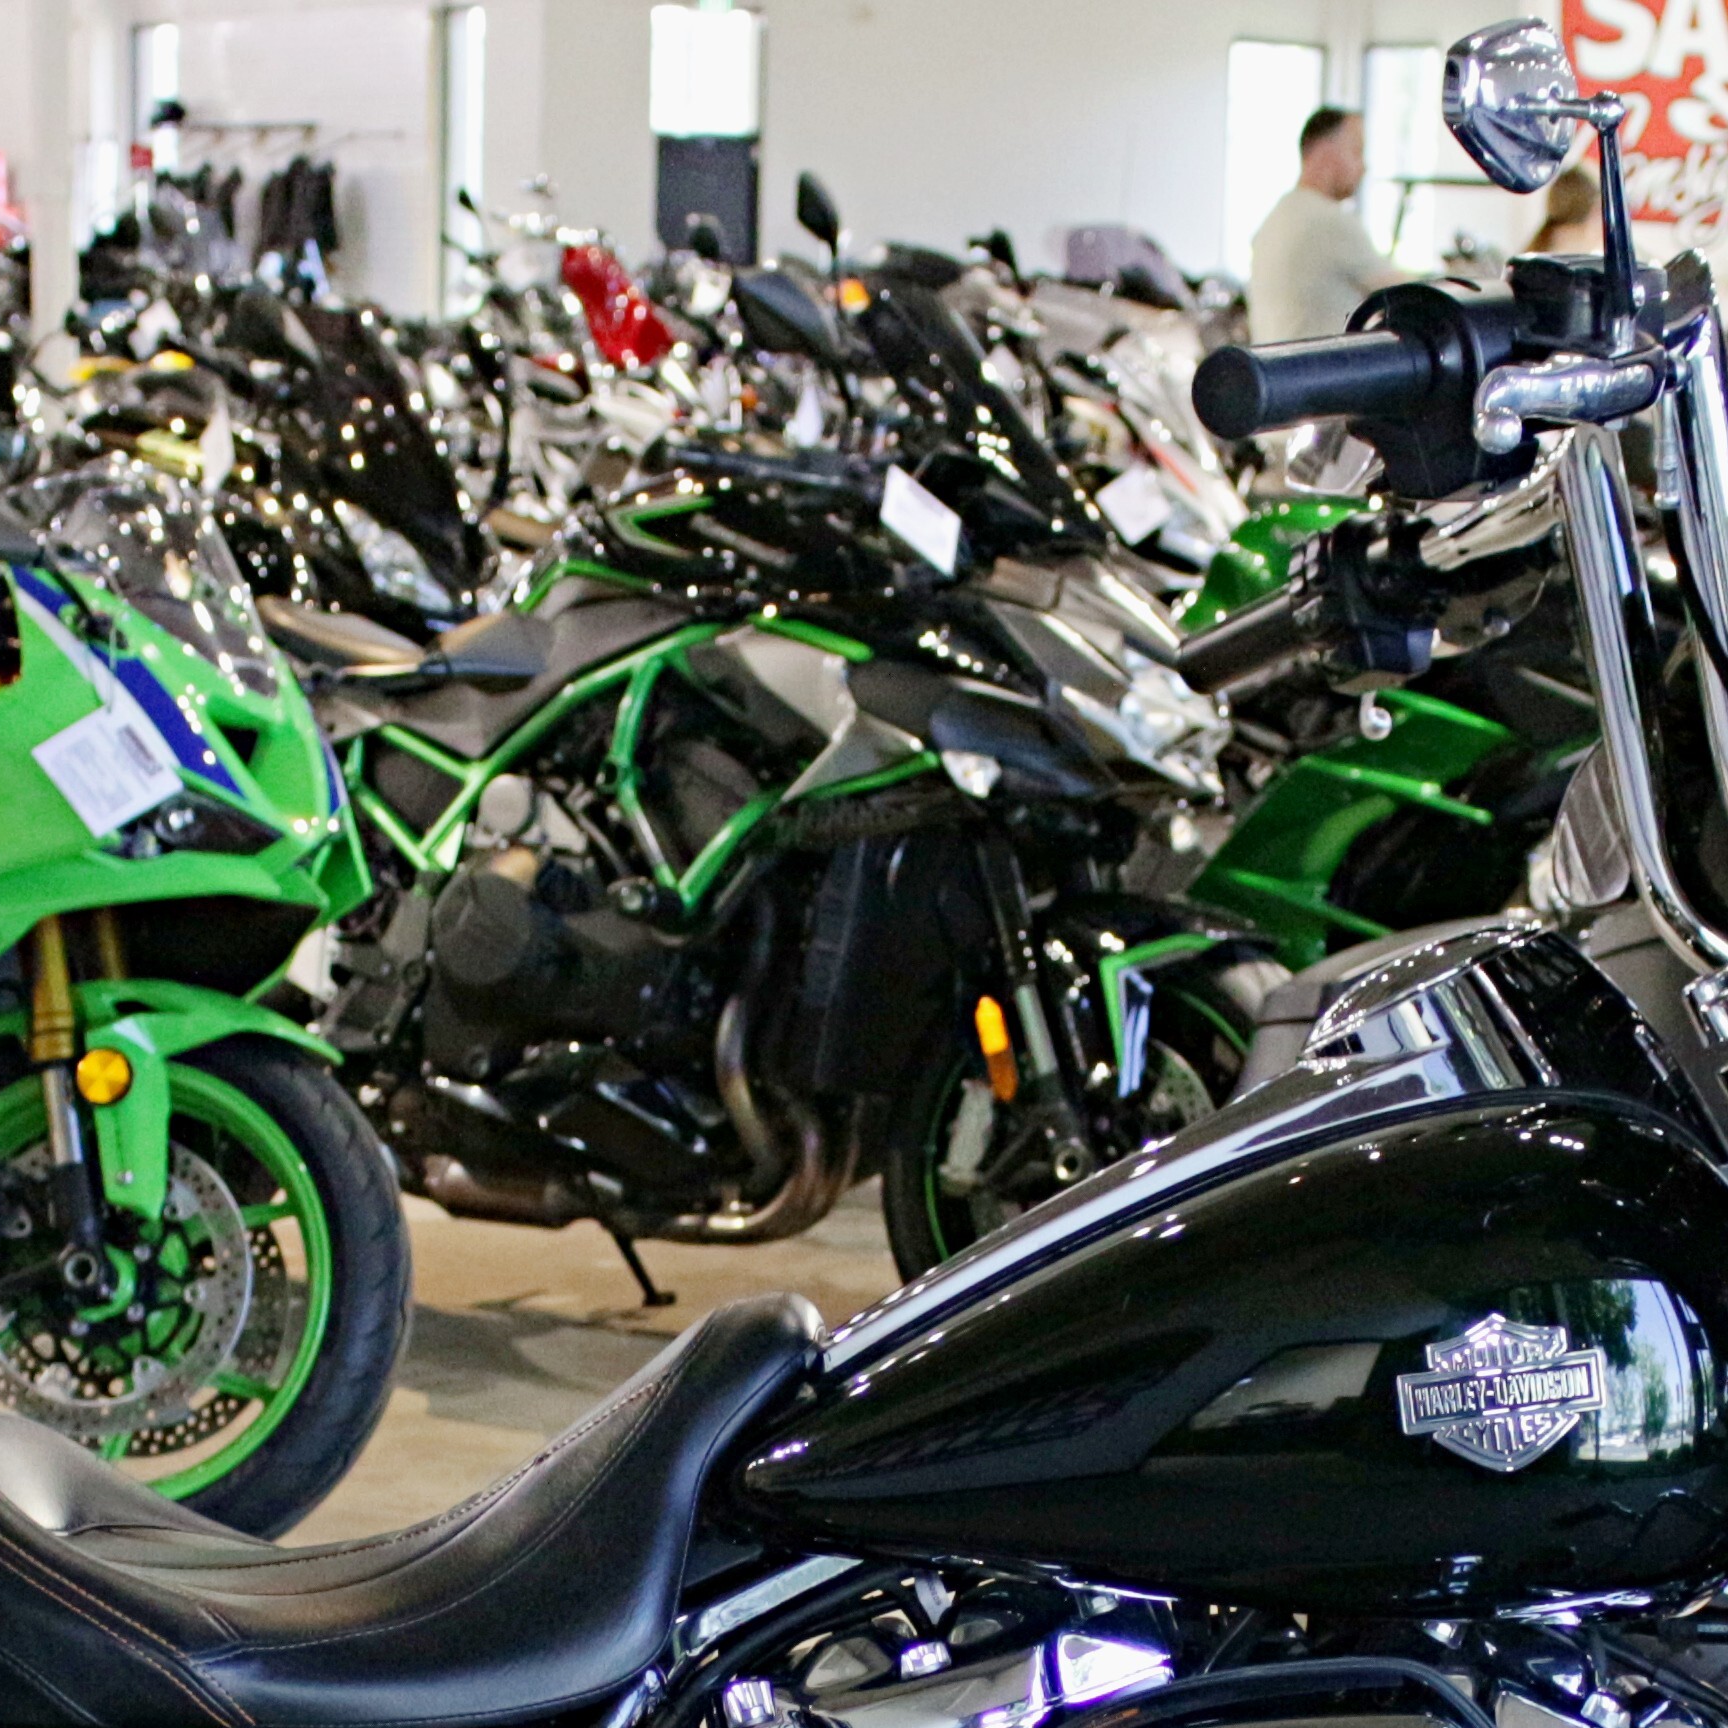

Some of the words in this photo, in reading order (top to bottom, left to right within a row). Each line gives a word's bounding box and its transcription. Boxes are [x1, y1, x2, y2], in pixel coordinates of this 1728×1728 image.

[1452, 1333, 1544, 1372] MOTOR
[1414, 1366, 1590, 1417] HARLEY-DAVIDSON
[1464, 1413, 1551, 1451] CYCLES
